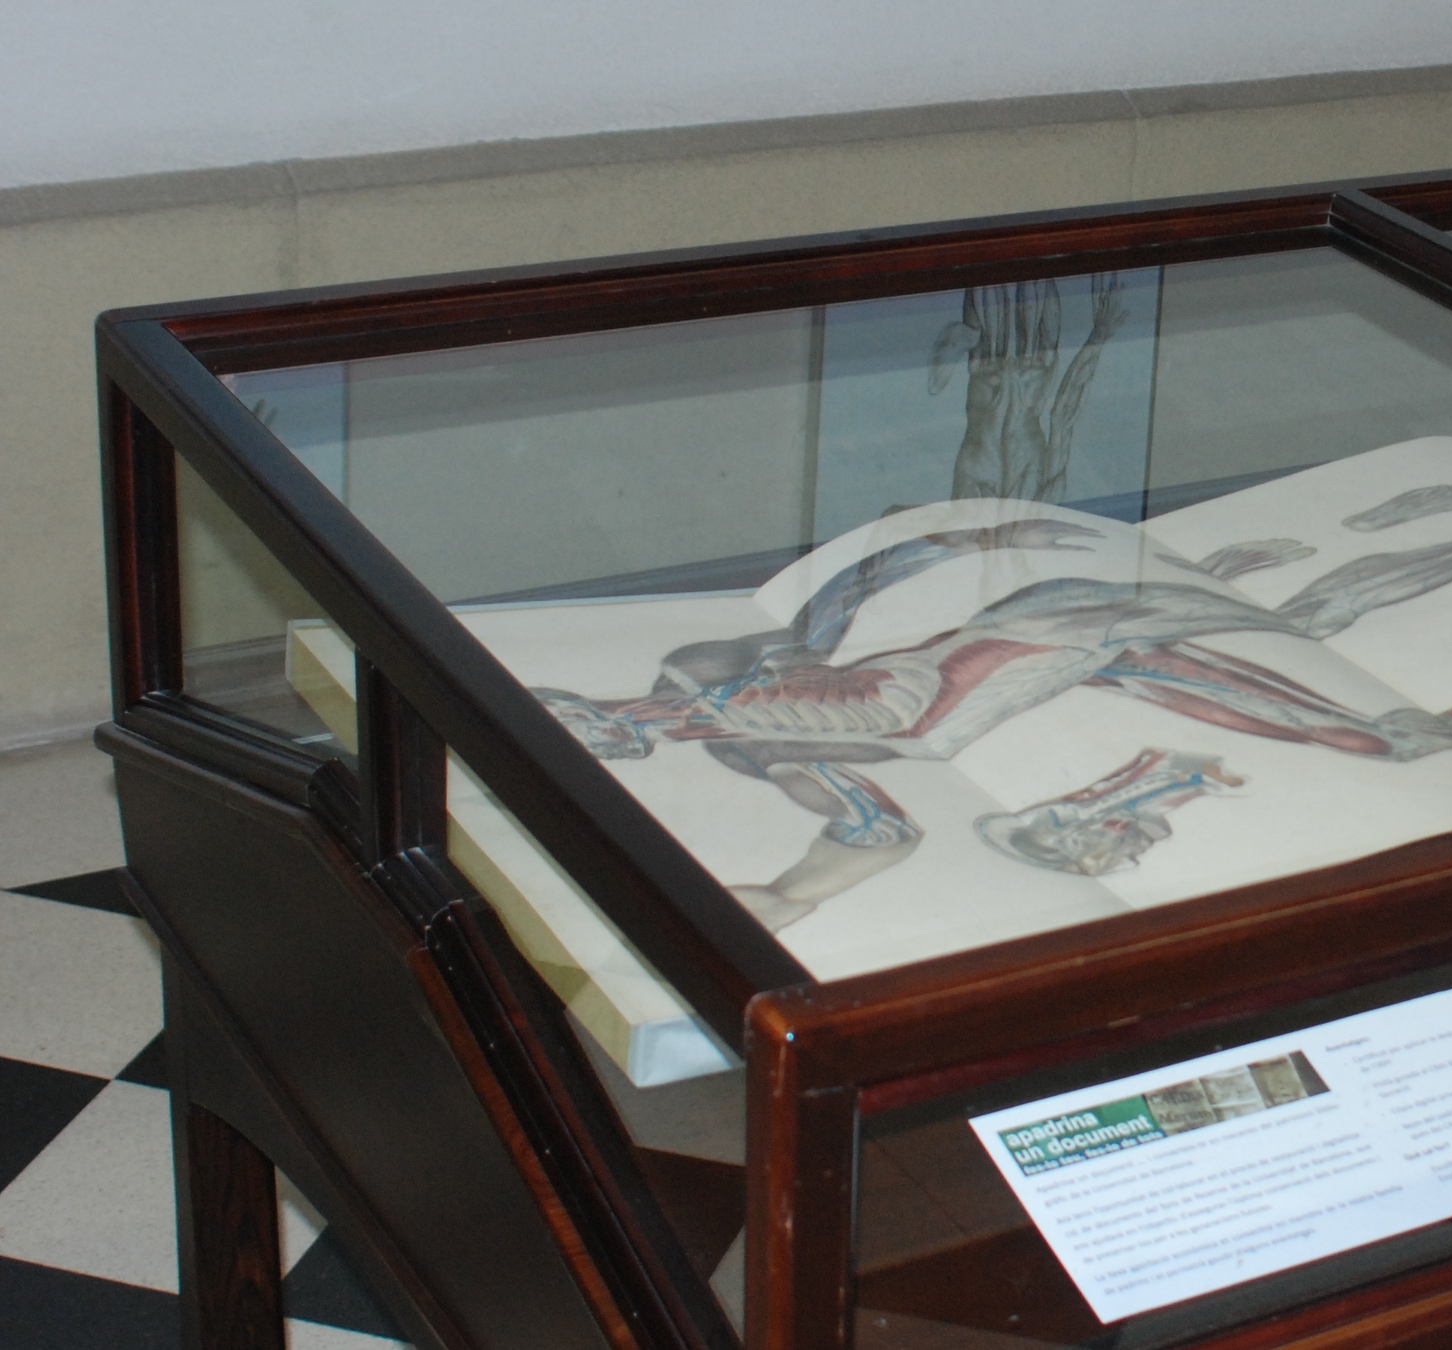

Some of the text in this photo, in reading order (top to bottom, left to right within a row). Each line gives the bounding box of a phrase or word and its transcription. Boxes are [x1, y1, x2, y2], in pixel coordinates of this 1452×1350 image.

[1005, 1112, 1099, 1147] apadrina
[1014, 1145, 1045, 1164] un
[1047, 1114, 1153, 1154] document
